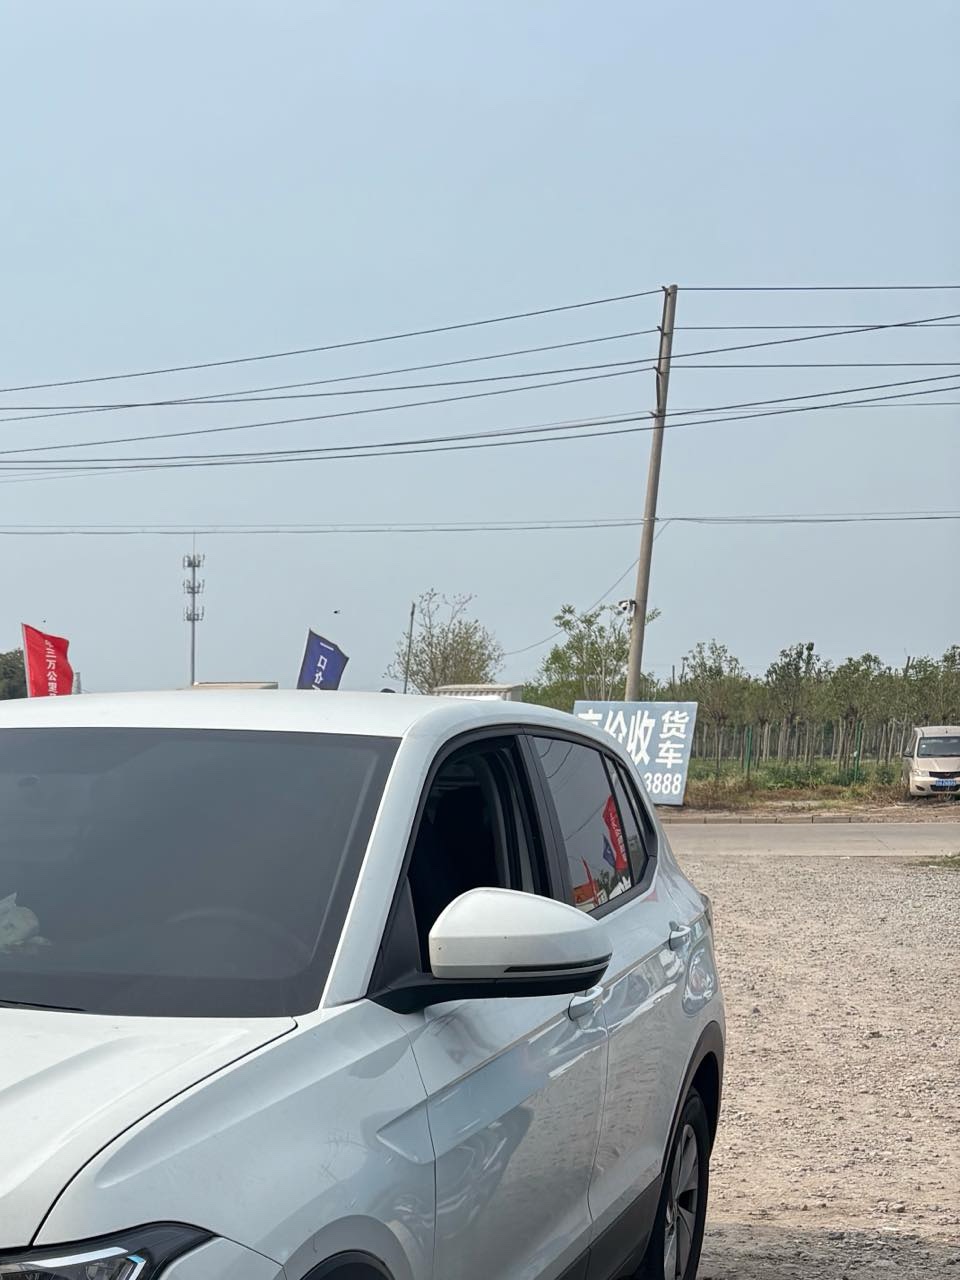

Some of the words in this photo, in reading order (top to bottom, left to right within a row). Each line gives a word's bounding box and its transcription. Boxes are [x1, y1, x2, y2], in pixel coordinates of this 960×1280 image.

[312, 642, 334, 689] 一口价
[655, 710, 690, 768] 货车
